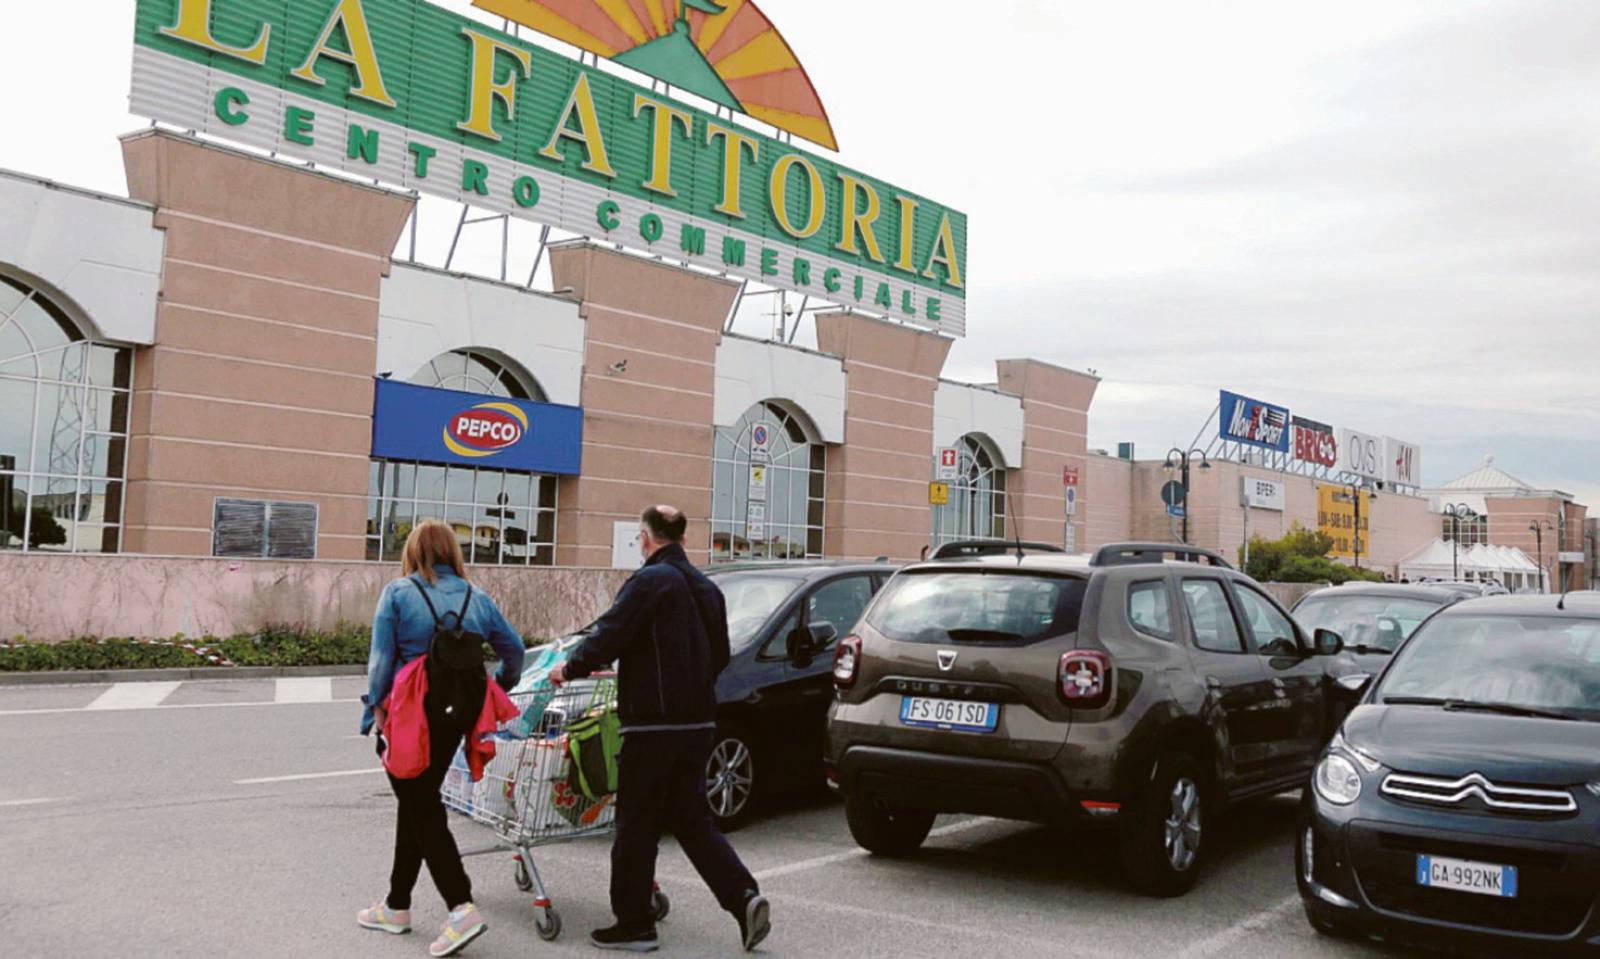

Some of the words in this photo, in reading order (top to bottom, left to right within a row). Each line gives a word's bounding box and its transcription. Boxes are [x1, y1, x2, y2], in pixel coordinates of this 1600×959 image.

[456, 27, 966, 289] FATTORIA
[213, 86, 541, 208] CENTRO
[596, 200, 941, 321] COMMERCIALE
[456, 416, 516, 442] PEPCO
[1295, 426, 1336, 468] BRICO
[1349, 435, 1376, 474] OVS
